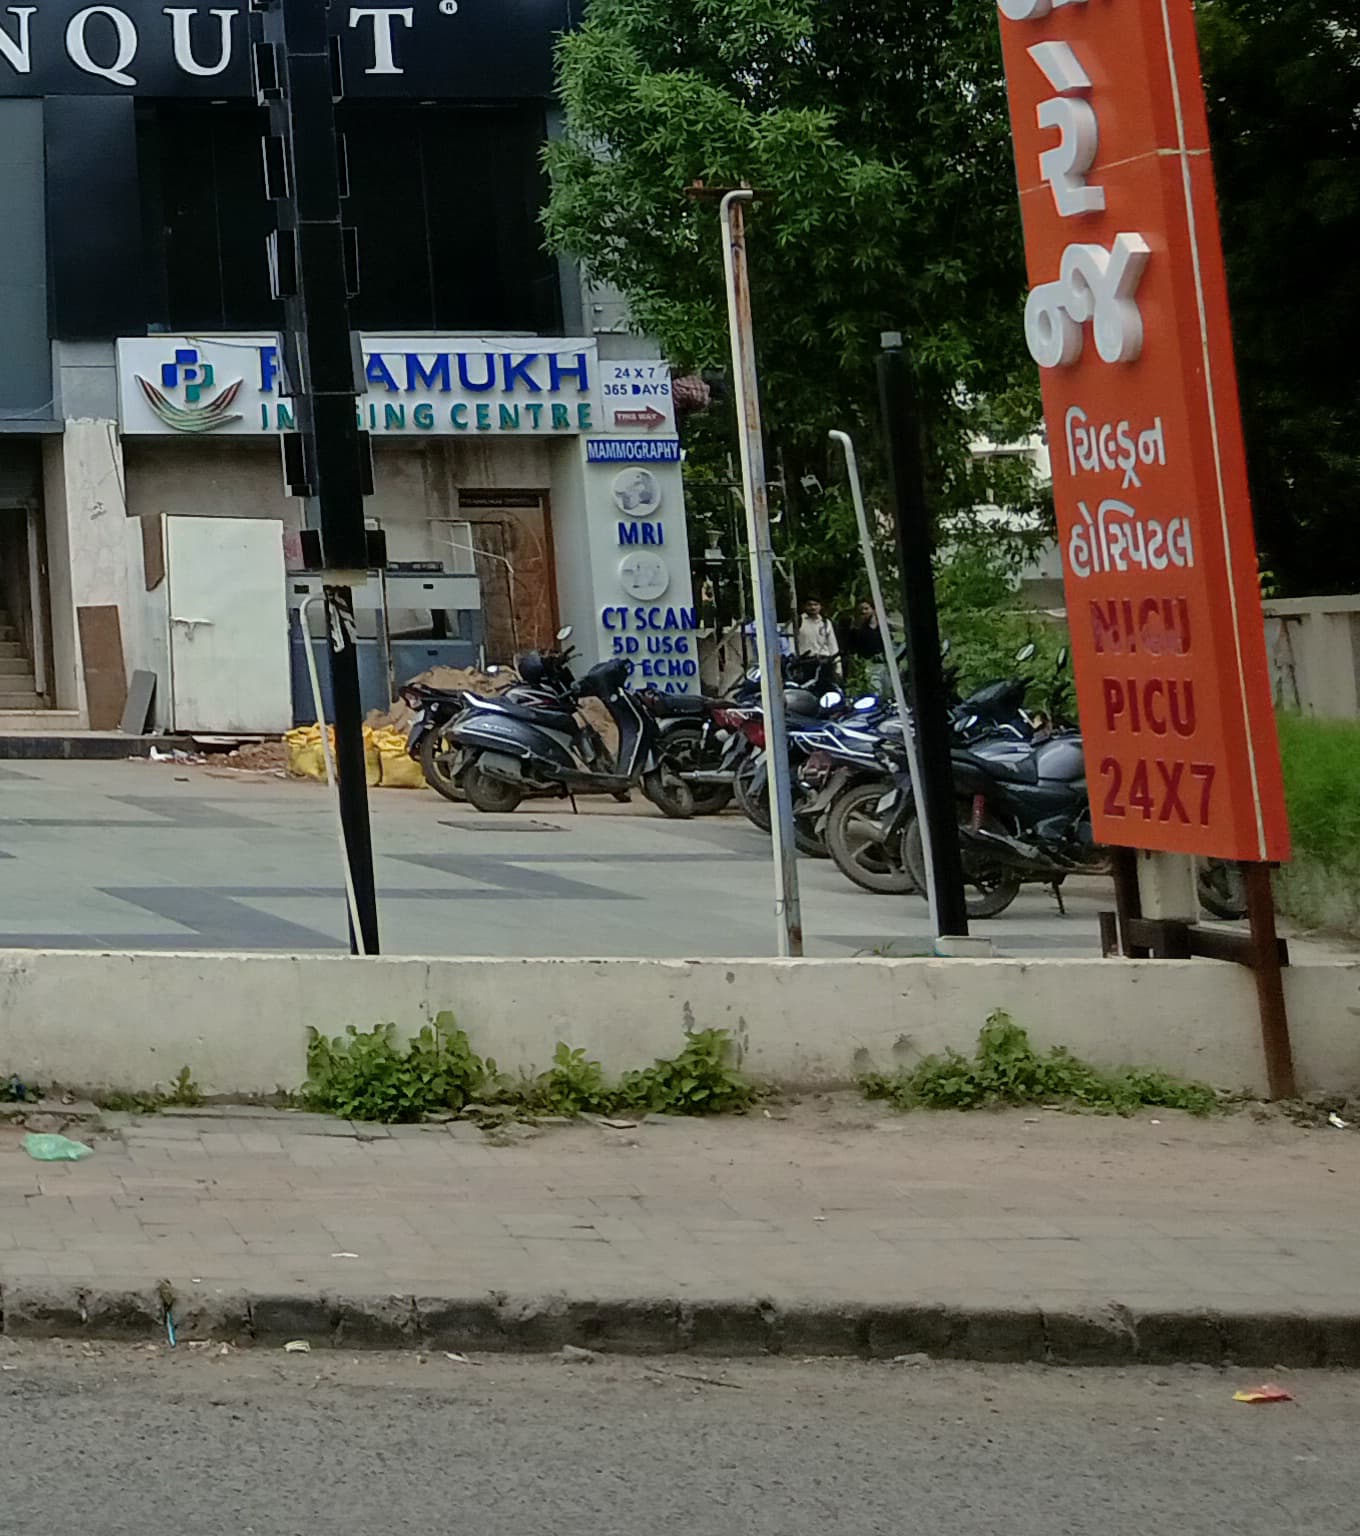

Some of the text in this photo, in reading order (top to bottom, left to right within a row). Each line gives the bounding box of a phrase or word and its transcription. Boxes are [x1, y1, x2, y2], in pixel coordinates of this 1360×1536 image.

[614, 367, 631, 378] 24
[648, 367, 656, 378] 7
[604, 383, 670, 396] 365 DAYS
[450, 402, 593, 431] CENTRE
[587, 441, 679, 460] MAMMOGRAPHY
[617, 521, 665, 545] MRI
[601, 606, 697, 631] CT SCAN
[1088, 596, 1193, 657] NICU
[646, 635, 689, 655] USG
[641, 659, 697, 677] ECHO
[1102, 676, 1197, 738] PICU
[1099, 756, 1217, 828] 24X7
